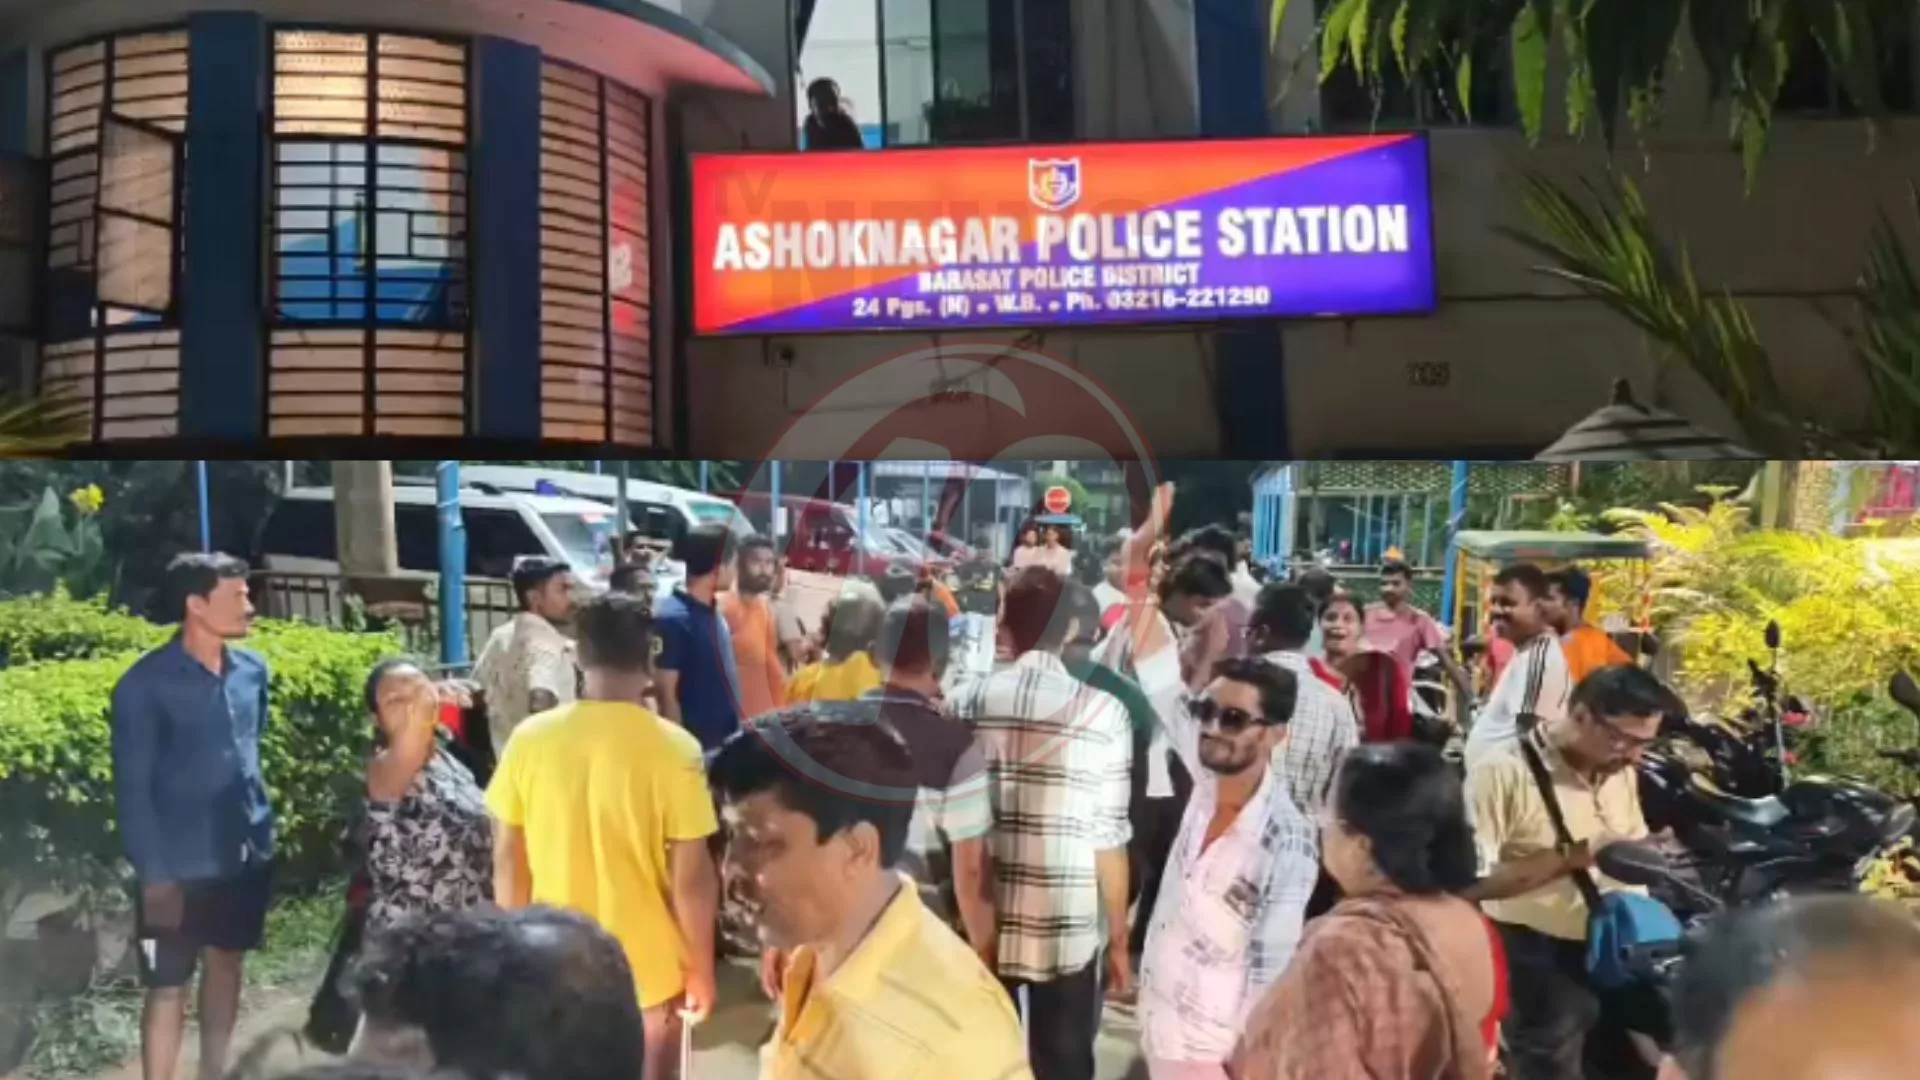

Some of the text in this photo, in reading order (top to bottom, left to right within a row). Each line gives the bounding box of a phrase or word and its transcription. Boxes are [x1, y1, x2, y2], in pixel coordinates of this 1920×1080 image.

[712, 203, 1409, 271] ASHOKNAGAR POLICE STATION
[917, 261, 1201, 294] BARASAT POLICE DISTRICT
[852, 297, 880, 318] 24
